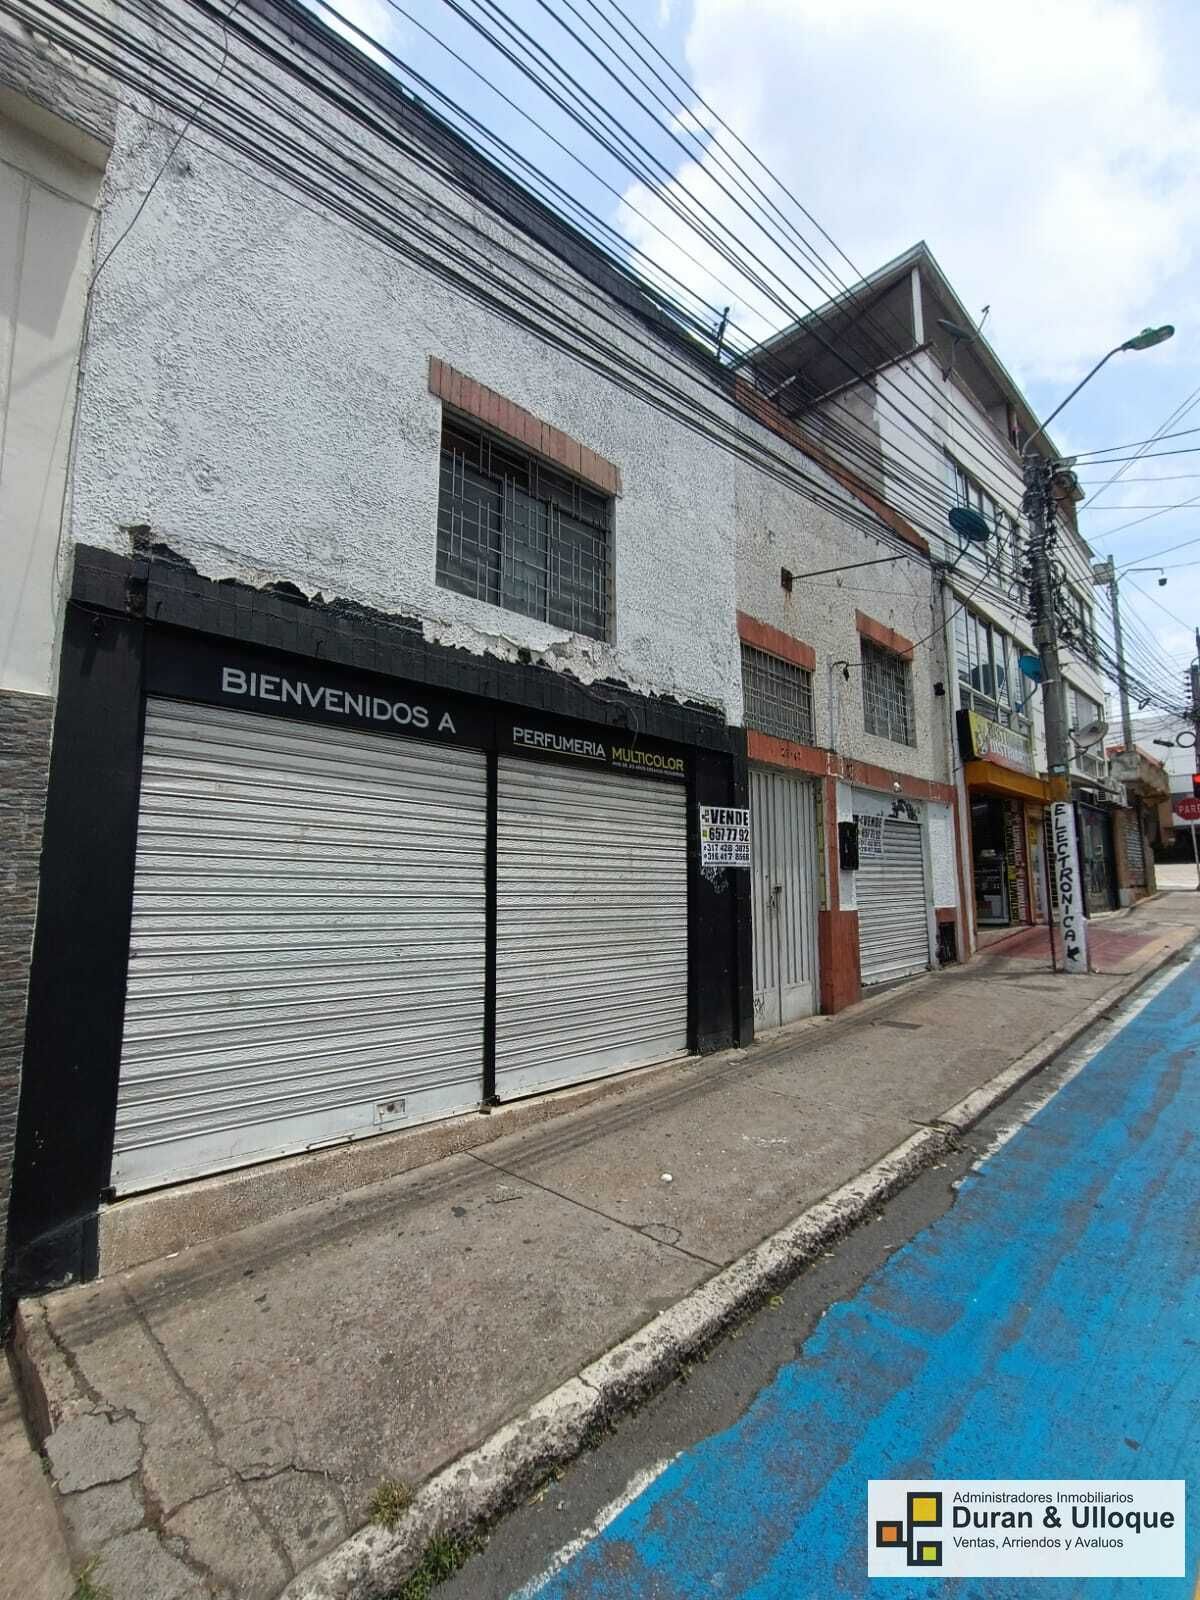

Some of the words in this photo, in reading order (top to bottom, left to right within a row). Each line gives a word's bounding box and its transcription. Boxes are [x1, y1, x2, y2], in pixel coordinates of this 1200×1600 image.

[221, 667, 430, 728] BIENVENIDOS
[437, 712, 457, 734] A
[513, 727, 606, 757] PERFUMERIA
[612, 746, 684, 772] MULTICOLOR
[710, 809, 749, 826] VENDE
[1054, 803, 1076, 942] ELECTRONICA
